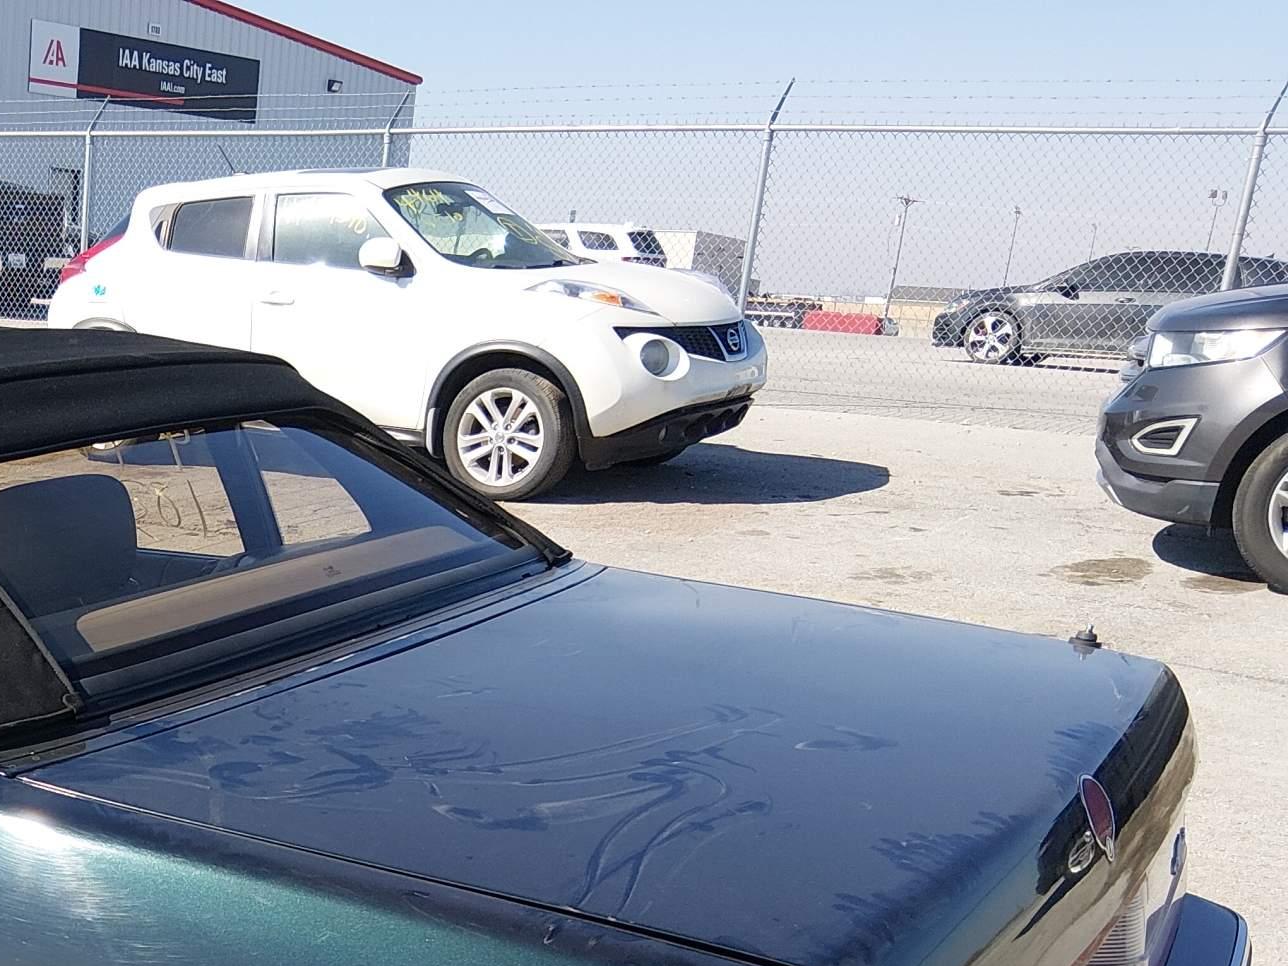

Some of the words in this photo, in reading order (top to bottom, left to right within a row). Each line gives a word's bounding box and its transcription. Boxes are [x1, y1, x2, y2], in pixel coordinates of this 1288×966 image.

[119, 47, 140, 69] IAA
[142, 52, 180, 77] Kansas
[183, 59, 203, 83] City
[206, 63, 227, 84] East
